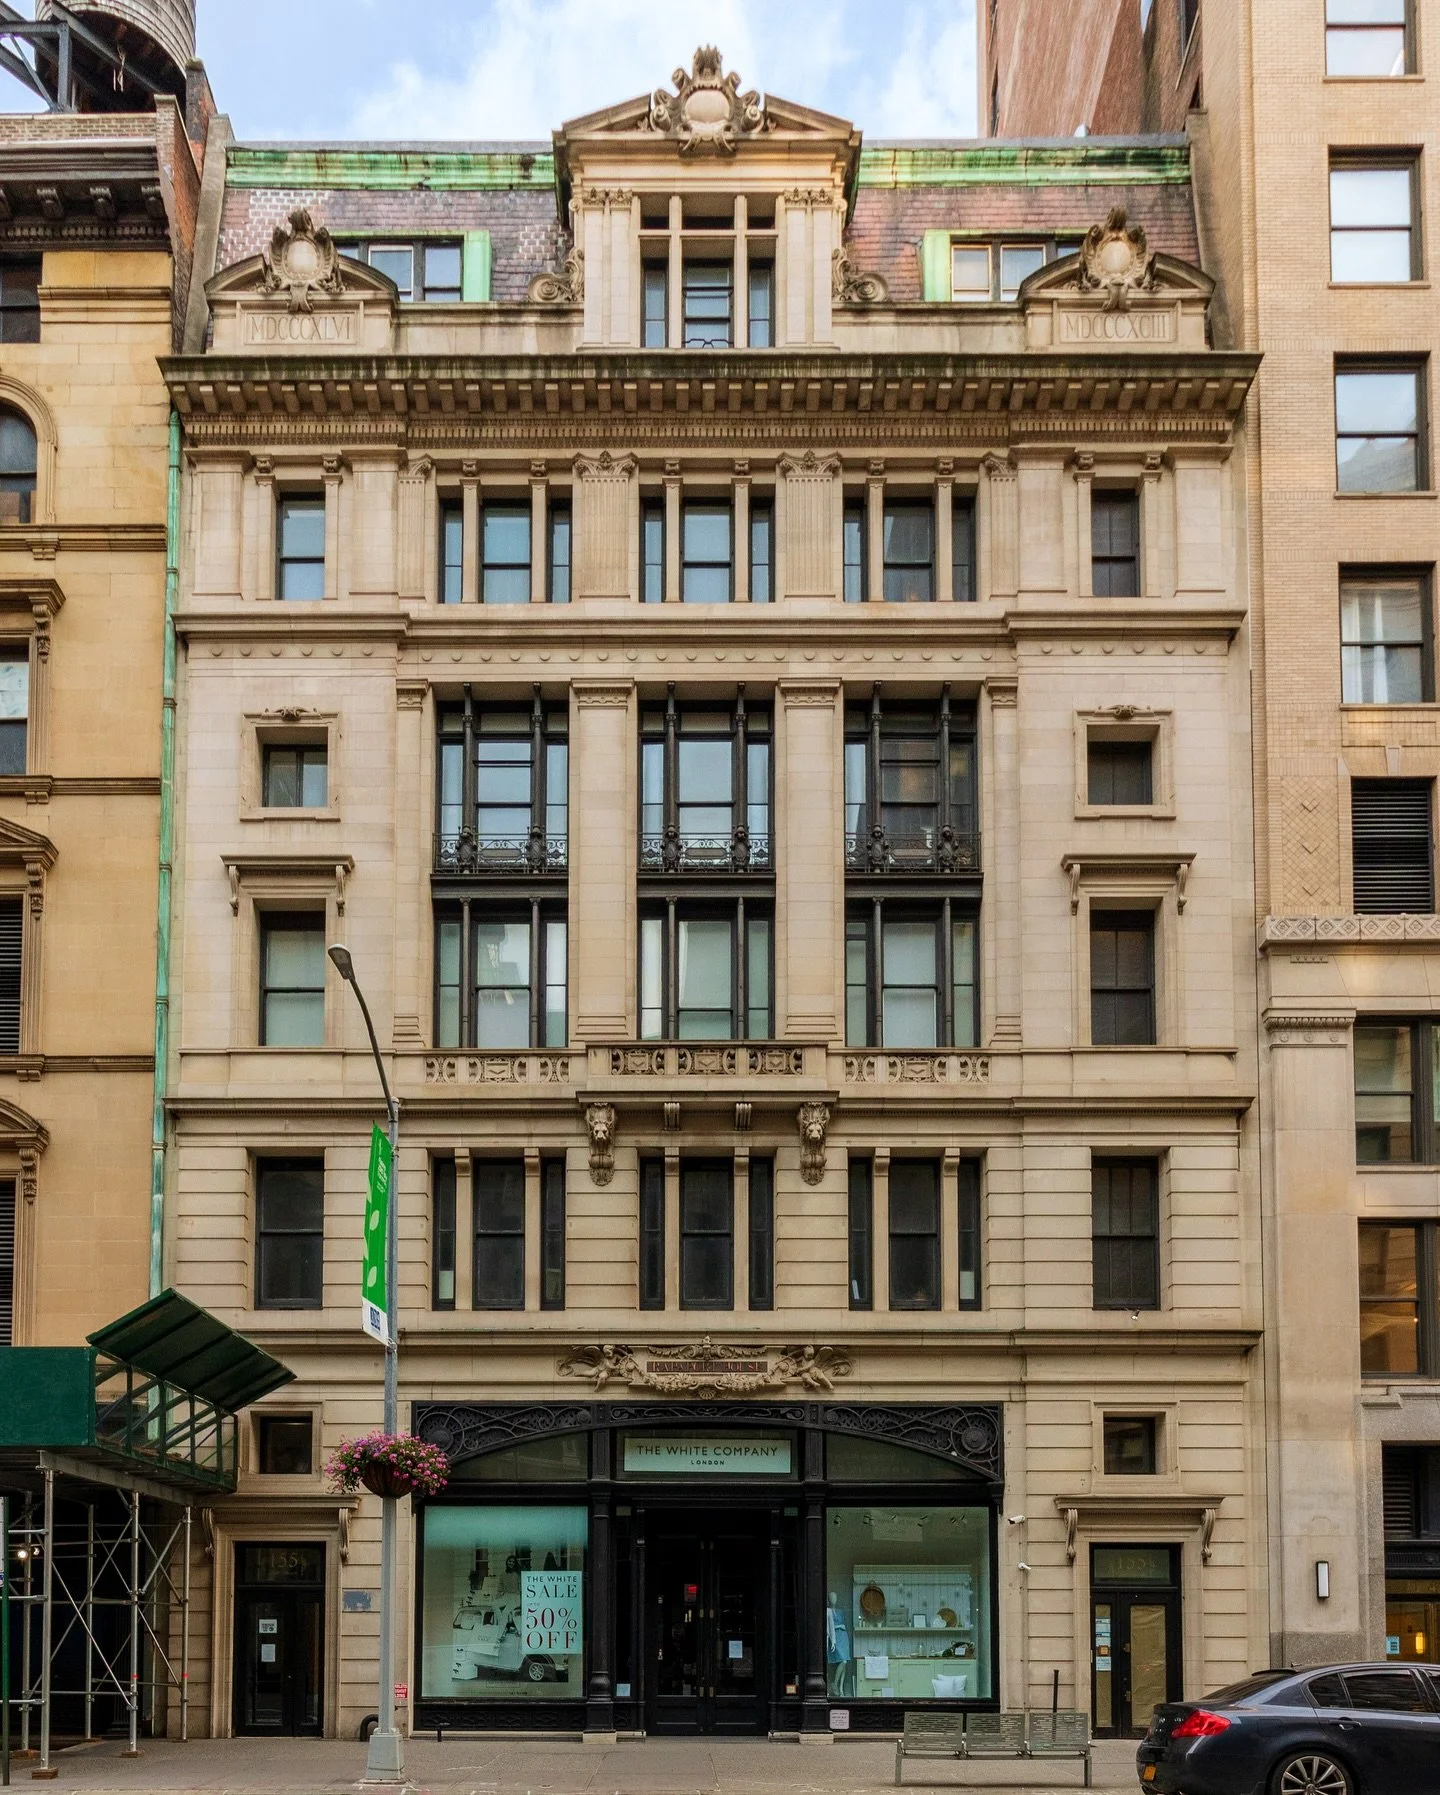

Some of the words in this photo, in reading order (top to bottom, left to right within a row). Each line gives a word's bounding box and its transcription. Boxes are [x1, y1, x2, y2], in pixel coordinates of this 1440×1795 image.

[251, 316, 350, 340] MDCCCXLVI
[1065, 314, 1166, 339] MDCCCXCIII
[636, 1445, 661, 1456] THE
[666, 1446, 708, 1456] WHITE
[713, 1446, 778, 1457] COMPANY
[526, 1575, 544, 1583] THE
[546, 1575, 577, 1583] WHITE
[526, 1584, 578, 1599] SALE
[526, 1607, 578, 1630] 50%
[526, 1630, 578, 1650] OFF
